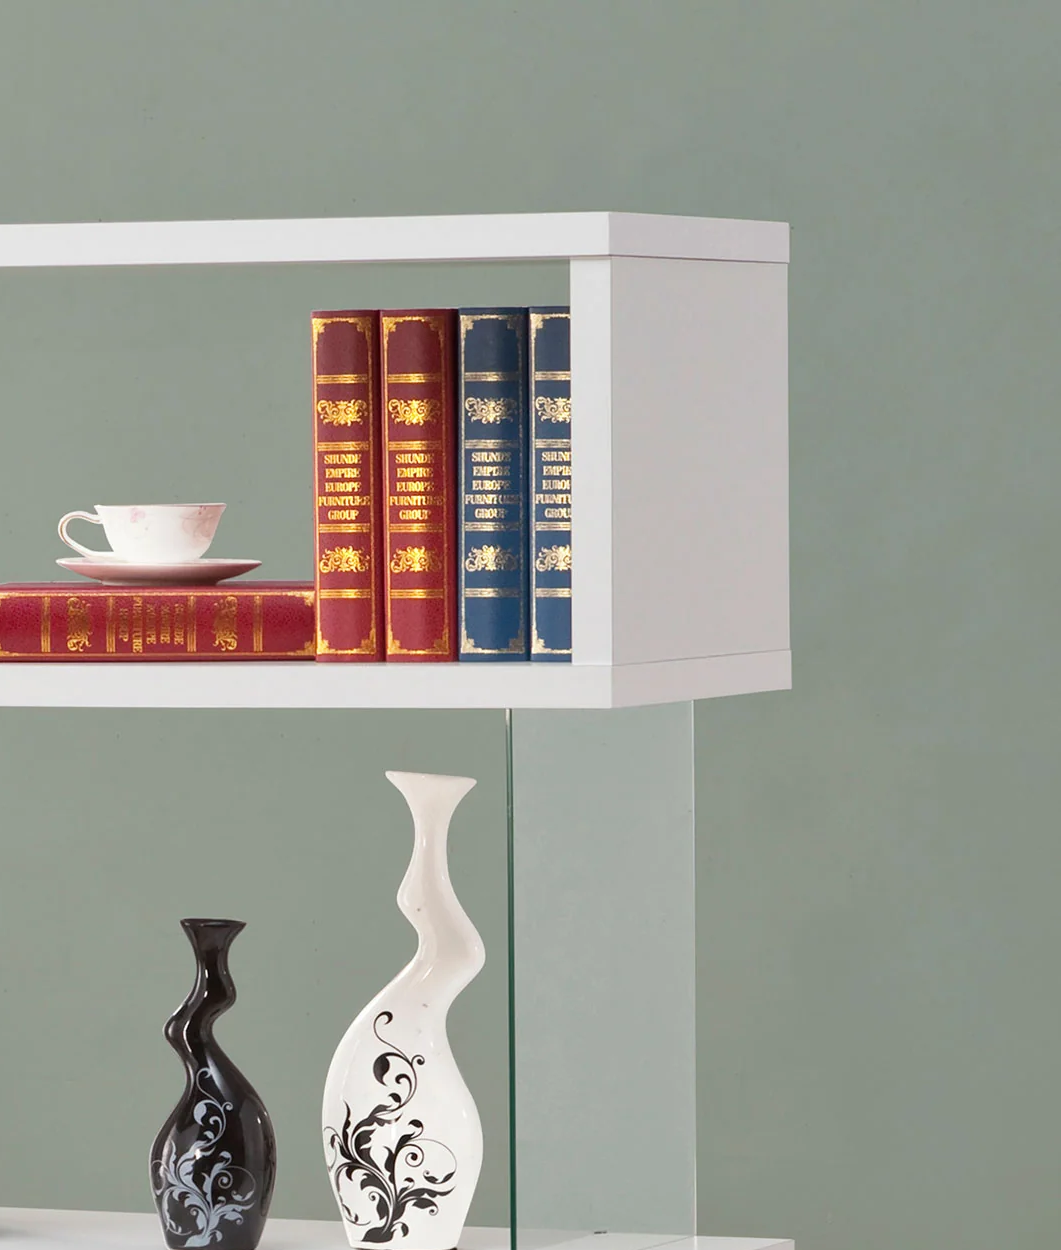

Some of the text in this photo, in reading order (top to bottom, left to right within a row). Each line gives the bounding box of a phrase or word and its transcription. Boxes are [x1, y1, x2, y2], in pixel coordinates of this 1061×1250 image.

[325, 468, 360, 478] EMPIRE
[328, 510, 359, 520] GROUP
[544, 508, 571, 518] GROU
